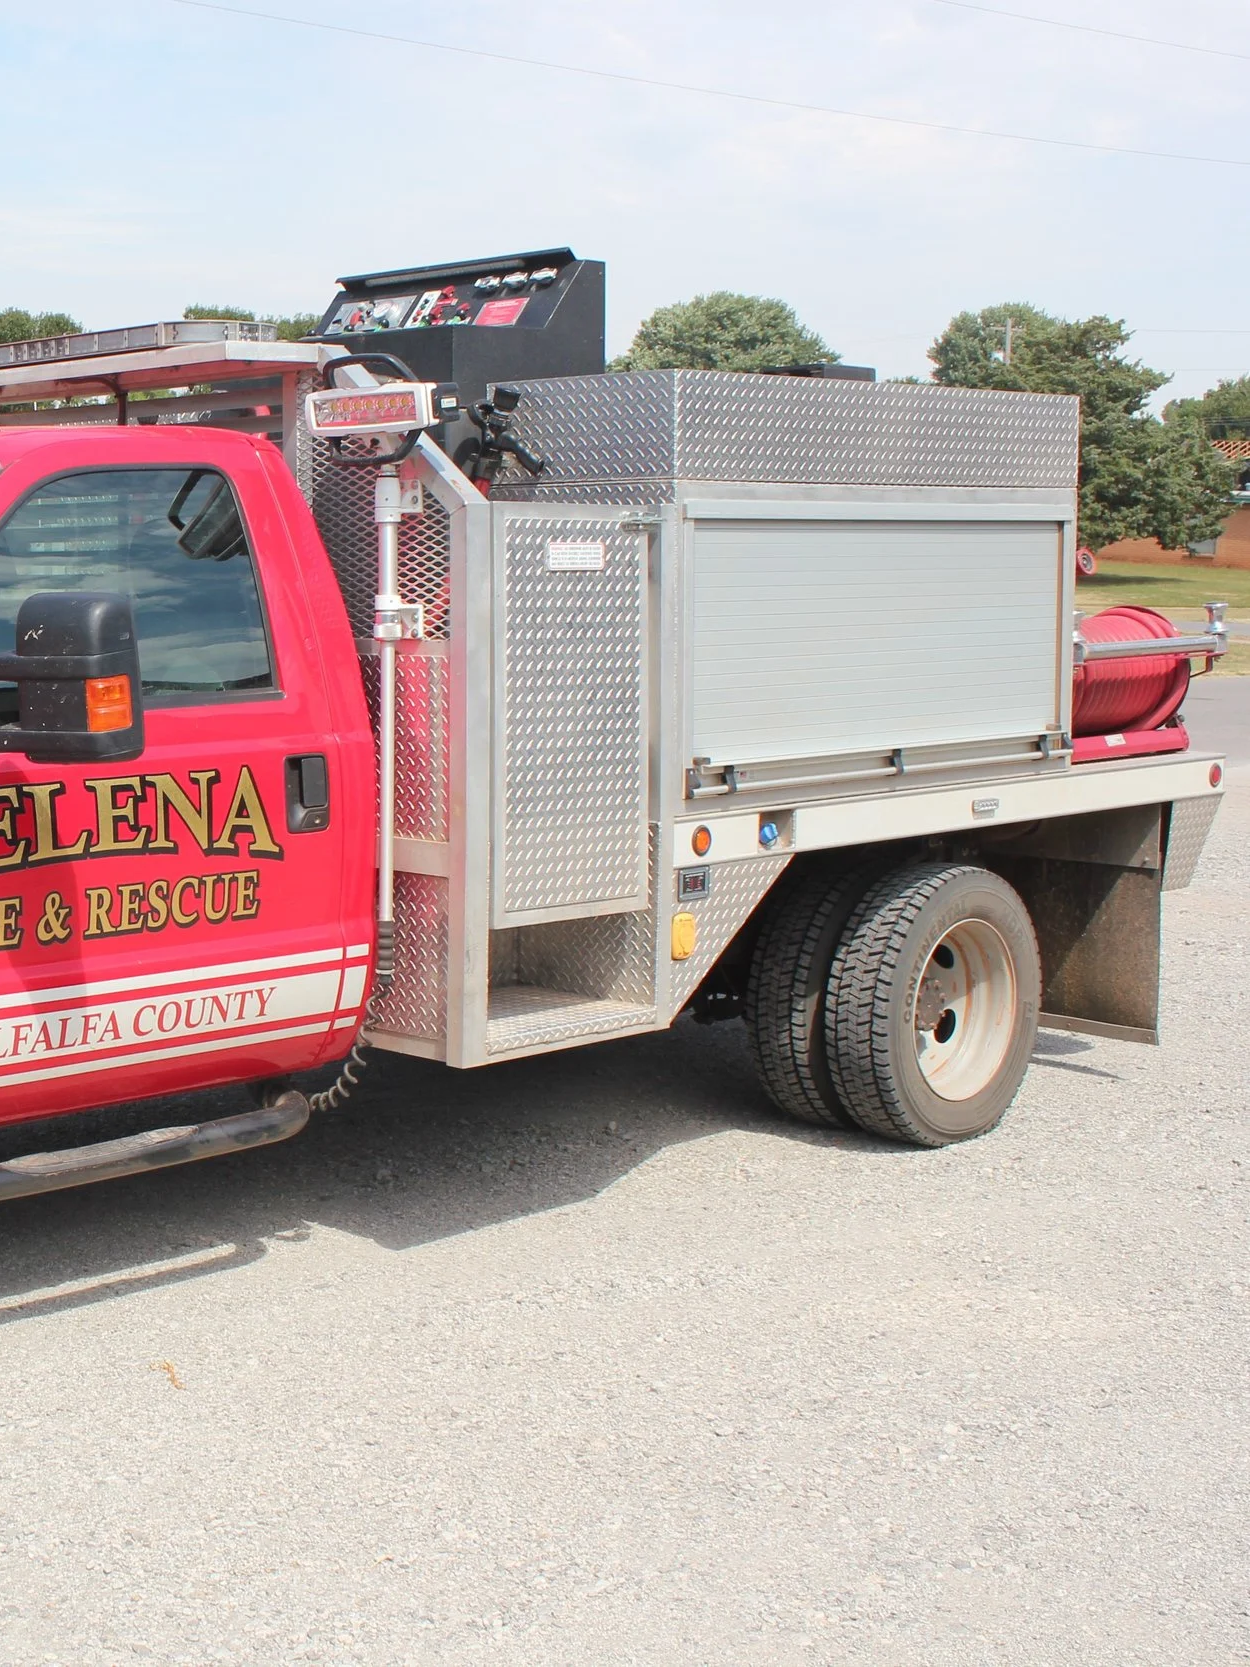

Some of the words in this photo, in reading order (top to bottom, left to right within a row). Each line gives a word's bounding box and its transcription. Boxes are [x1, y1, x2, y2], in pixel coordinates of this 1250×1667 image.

[36, 892, 72, 944] &
[83, 869, 259, 938] RESCUE
[132, 985, 277, 1036] COUNTY
